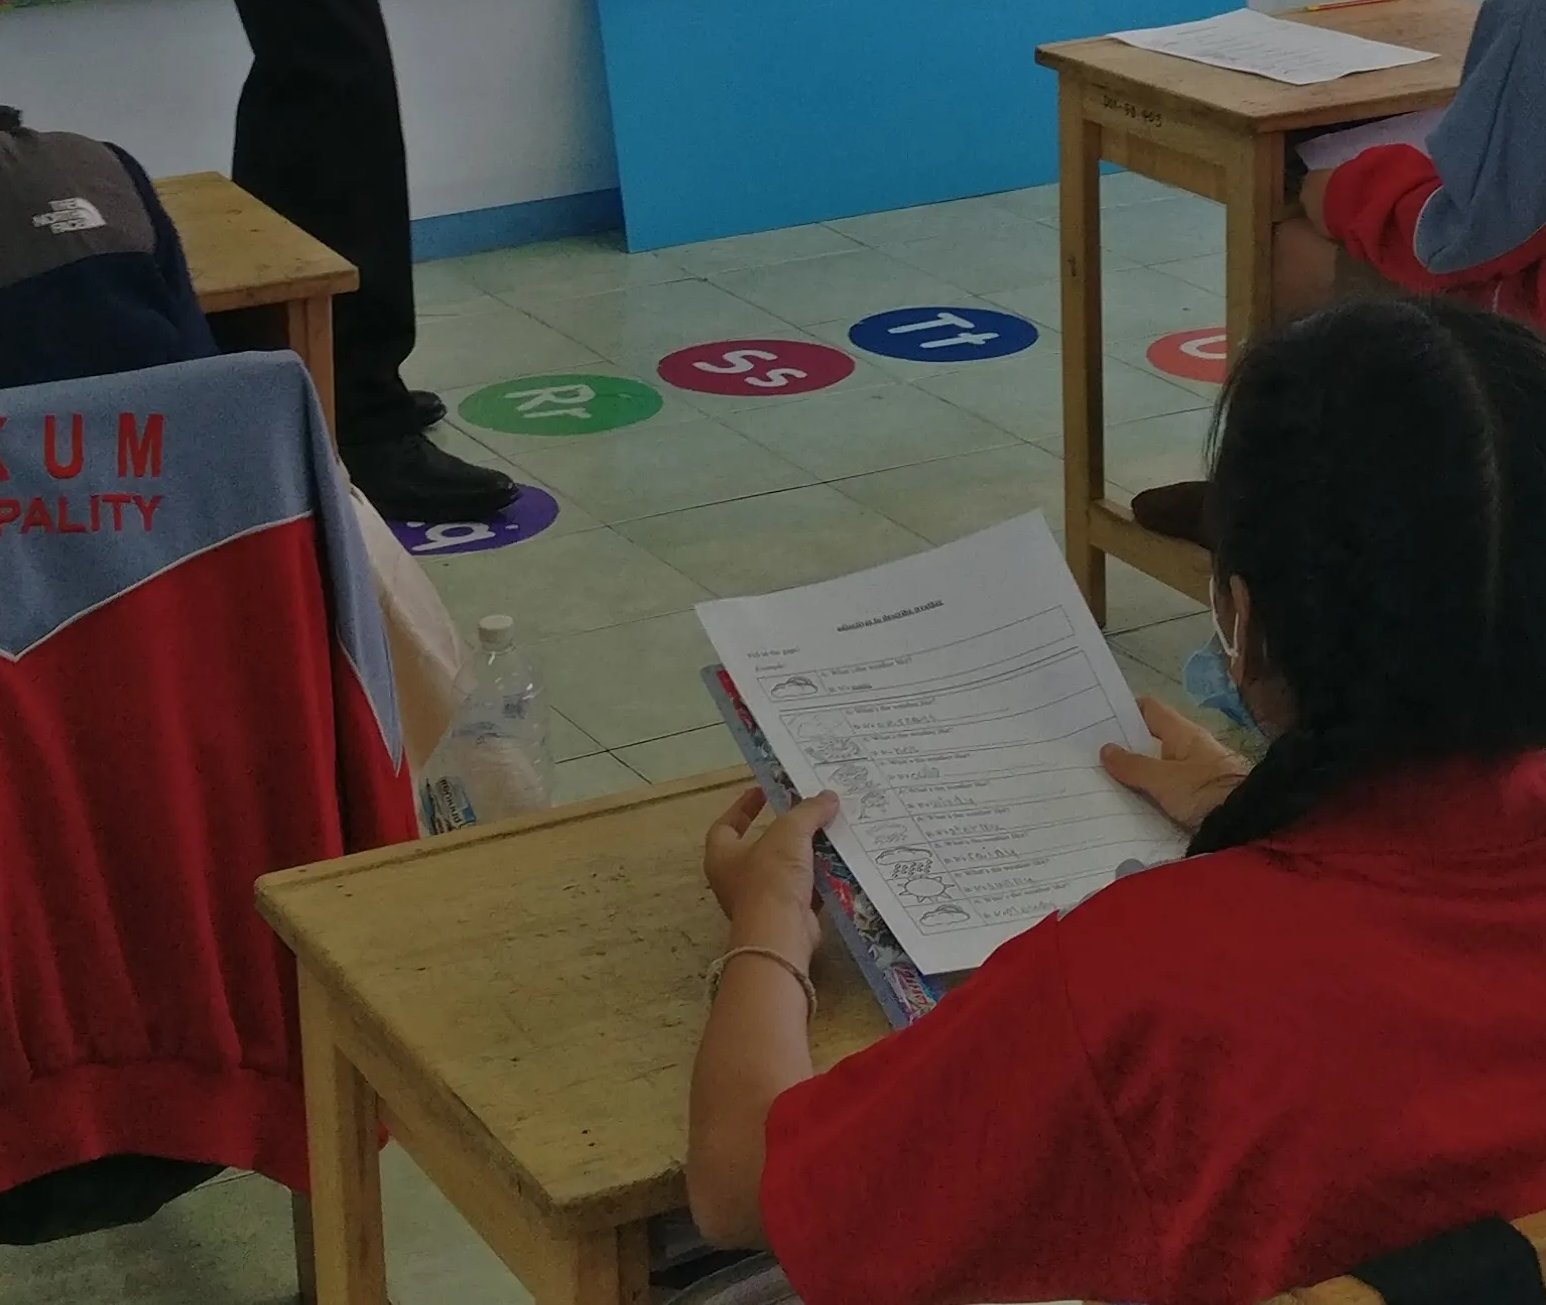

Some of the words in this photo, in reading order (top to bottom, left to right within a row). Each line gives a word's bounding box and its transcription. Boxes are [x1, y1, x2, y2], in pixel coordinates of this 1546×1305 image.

[887, 312, 1002, 351] Tt
[692, 348, 810, 390] Ss
[502, 382, 597, 422] Rr
